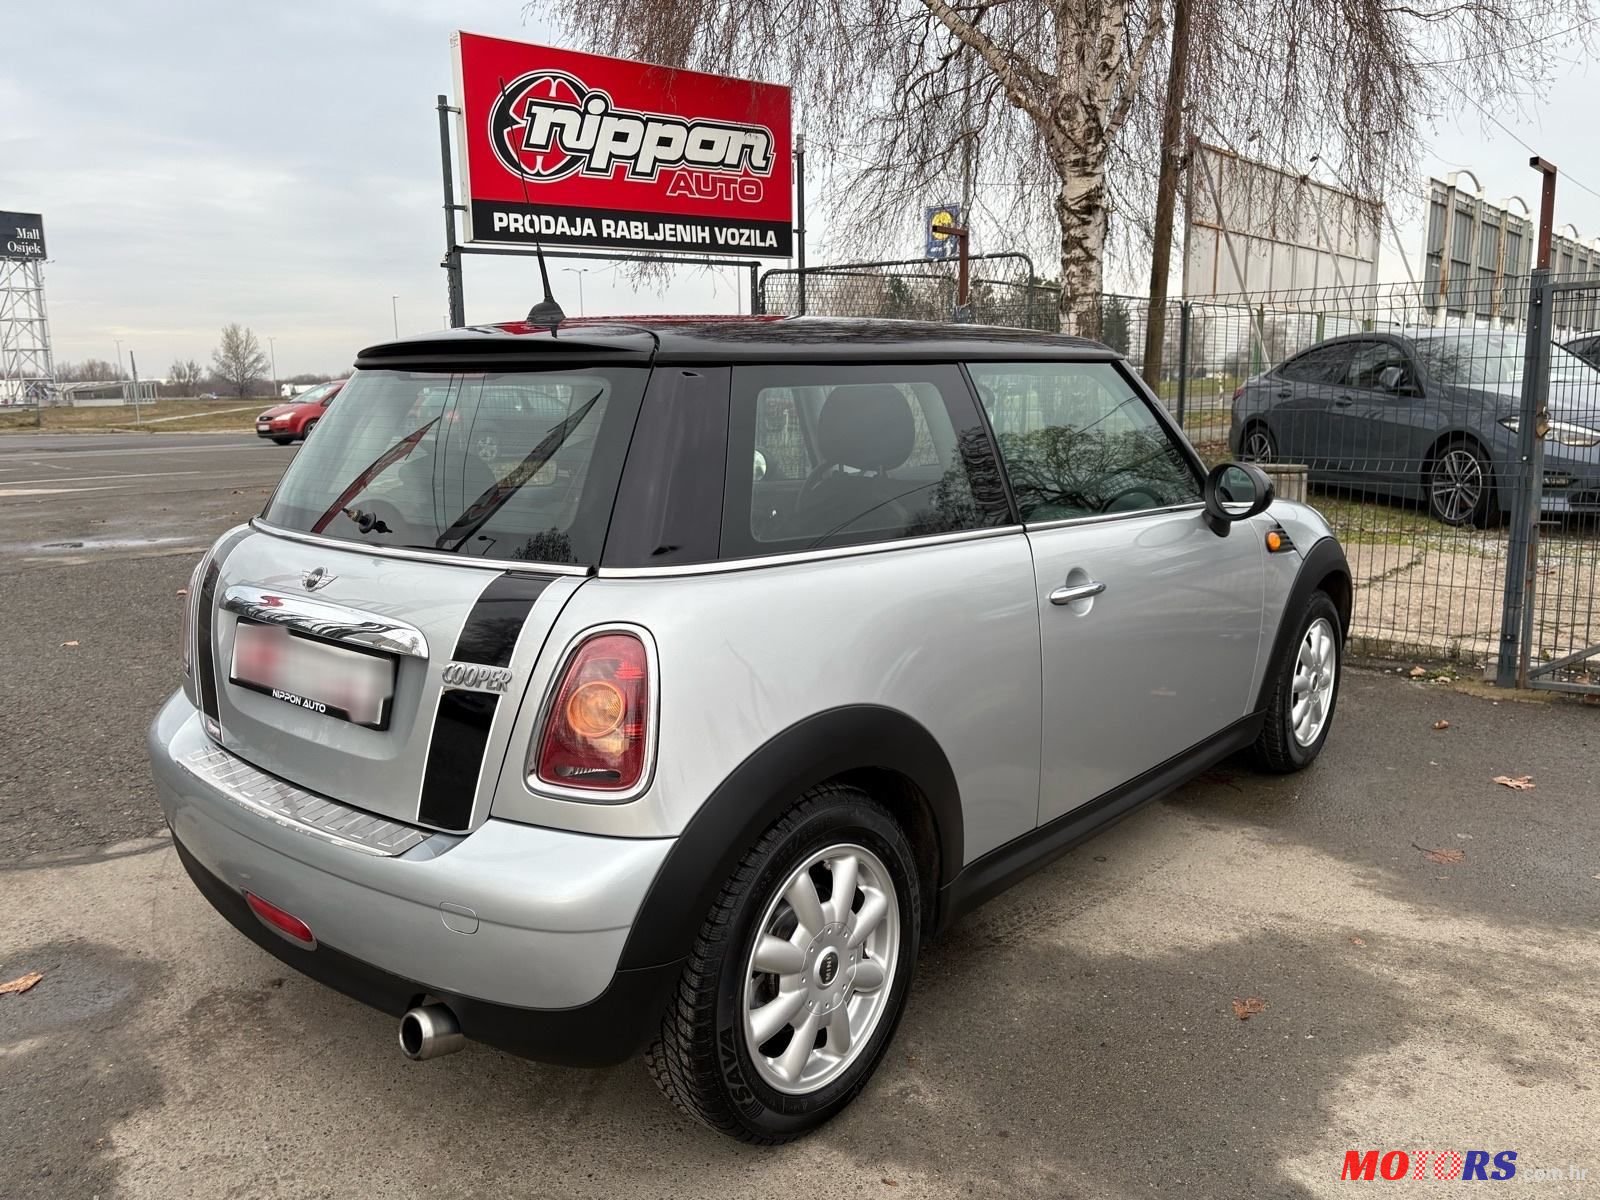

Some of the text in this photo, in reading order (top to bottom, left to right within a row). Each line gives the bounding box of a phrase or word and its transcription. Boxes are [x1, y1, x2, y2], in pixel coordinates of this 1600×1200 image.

[525, 92, 773, 179] nippon
[666, 171, 764, 203] AUTO
[15, 227, 40, 240] Mall
[493, 211, 778, 249] PRODAJA RABLJENIH VOZILA
[7, 240, 42, 256] Osijek
[442, 662, 512, 692] COOPER
[272, 688, 326, 713] NIPPON AUTO
[719, 1027, 764, 1117] SAVA
